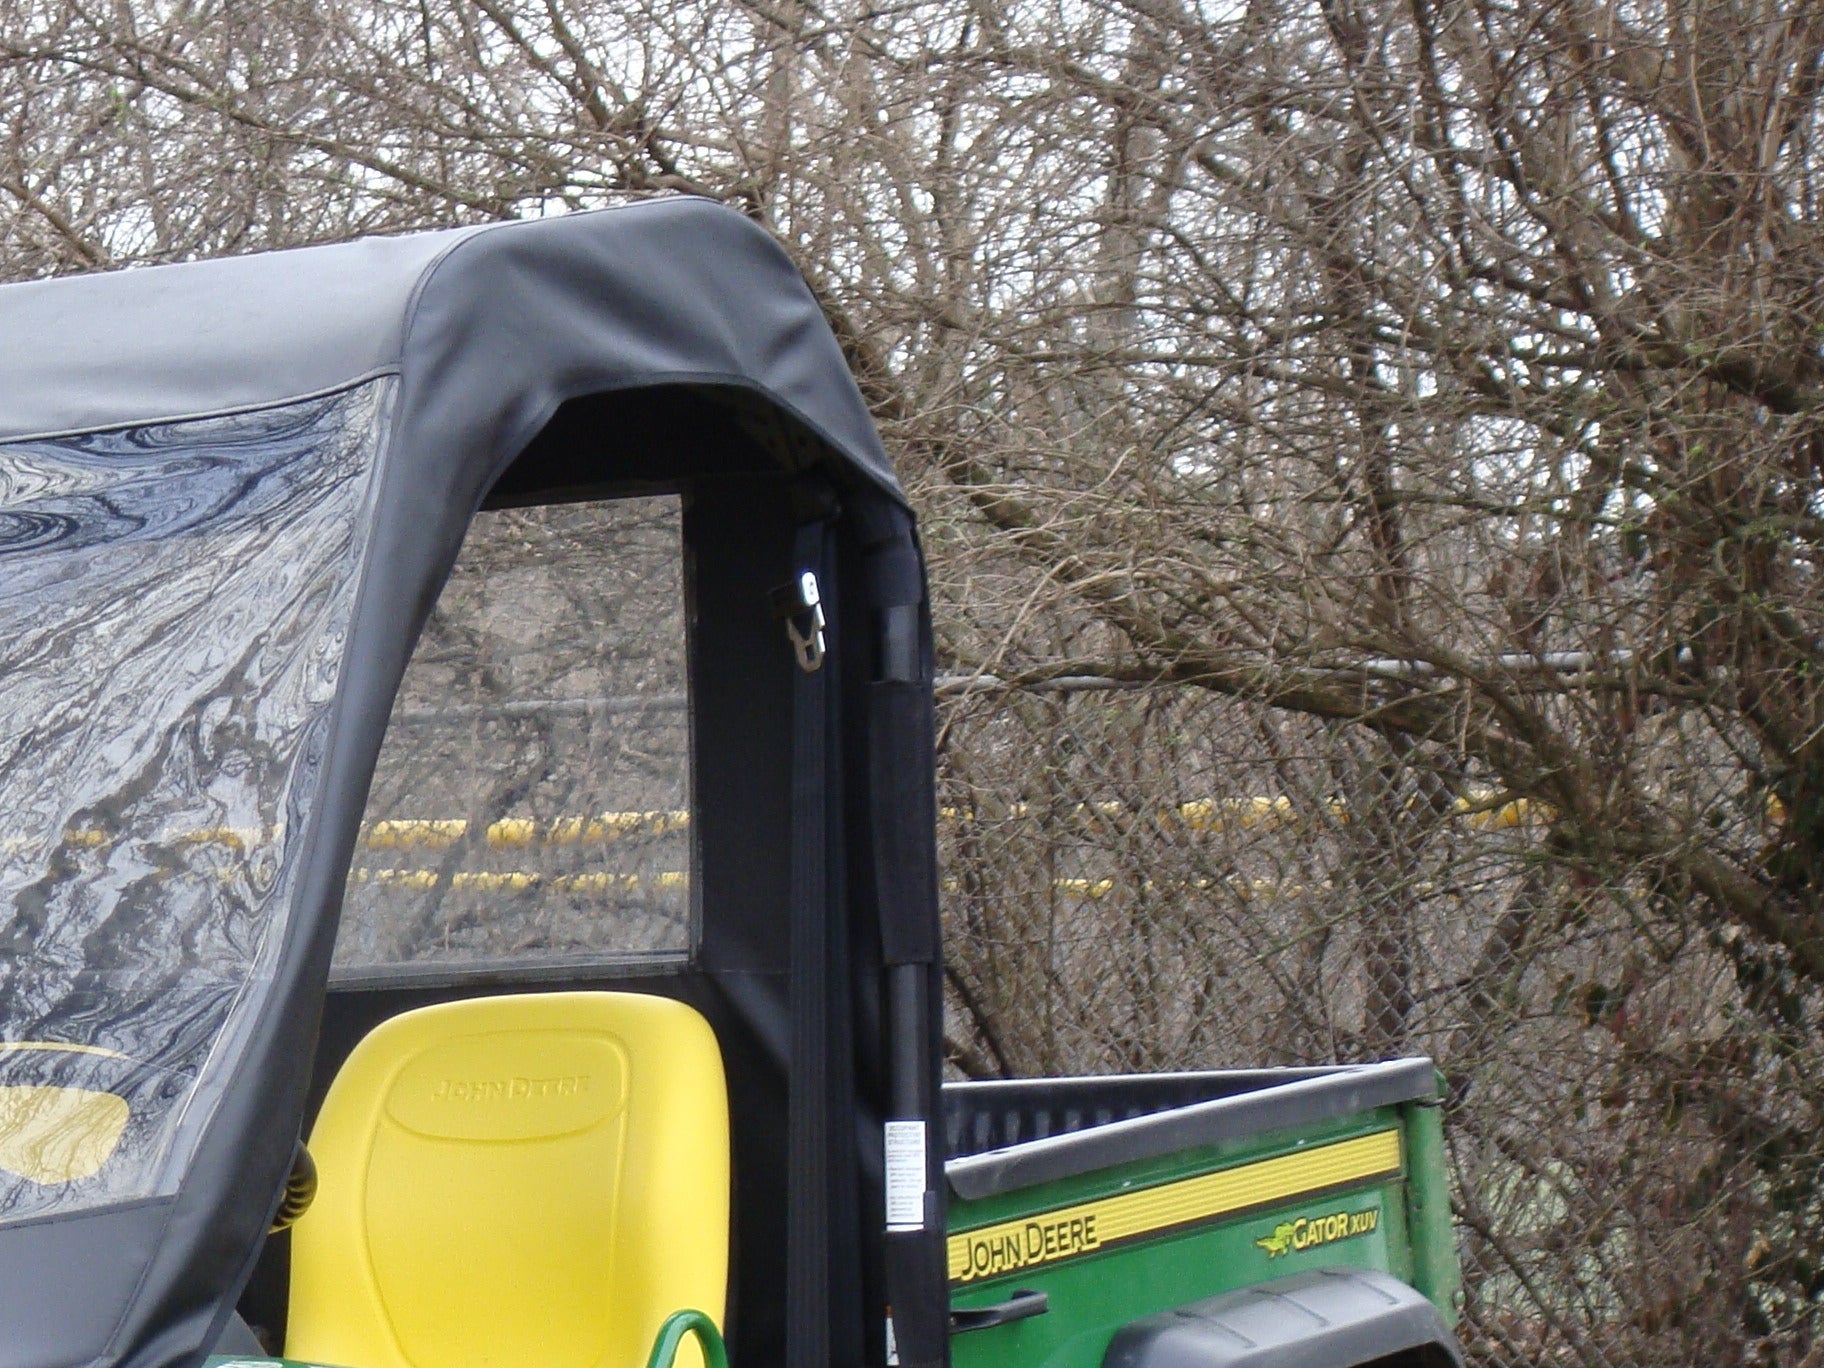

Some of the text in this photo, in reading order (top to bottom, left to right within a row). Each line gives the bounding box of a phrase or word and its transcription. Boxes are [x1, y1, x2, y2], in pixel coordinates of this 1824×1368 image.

[431, 1079, 507, 1101] JOHN
[961, 1215, 1098, 1276] JOHN DEERE
[1292, 1210, 1378, 1250] GATOR XUV
